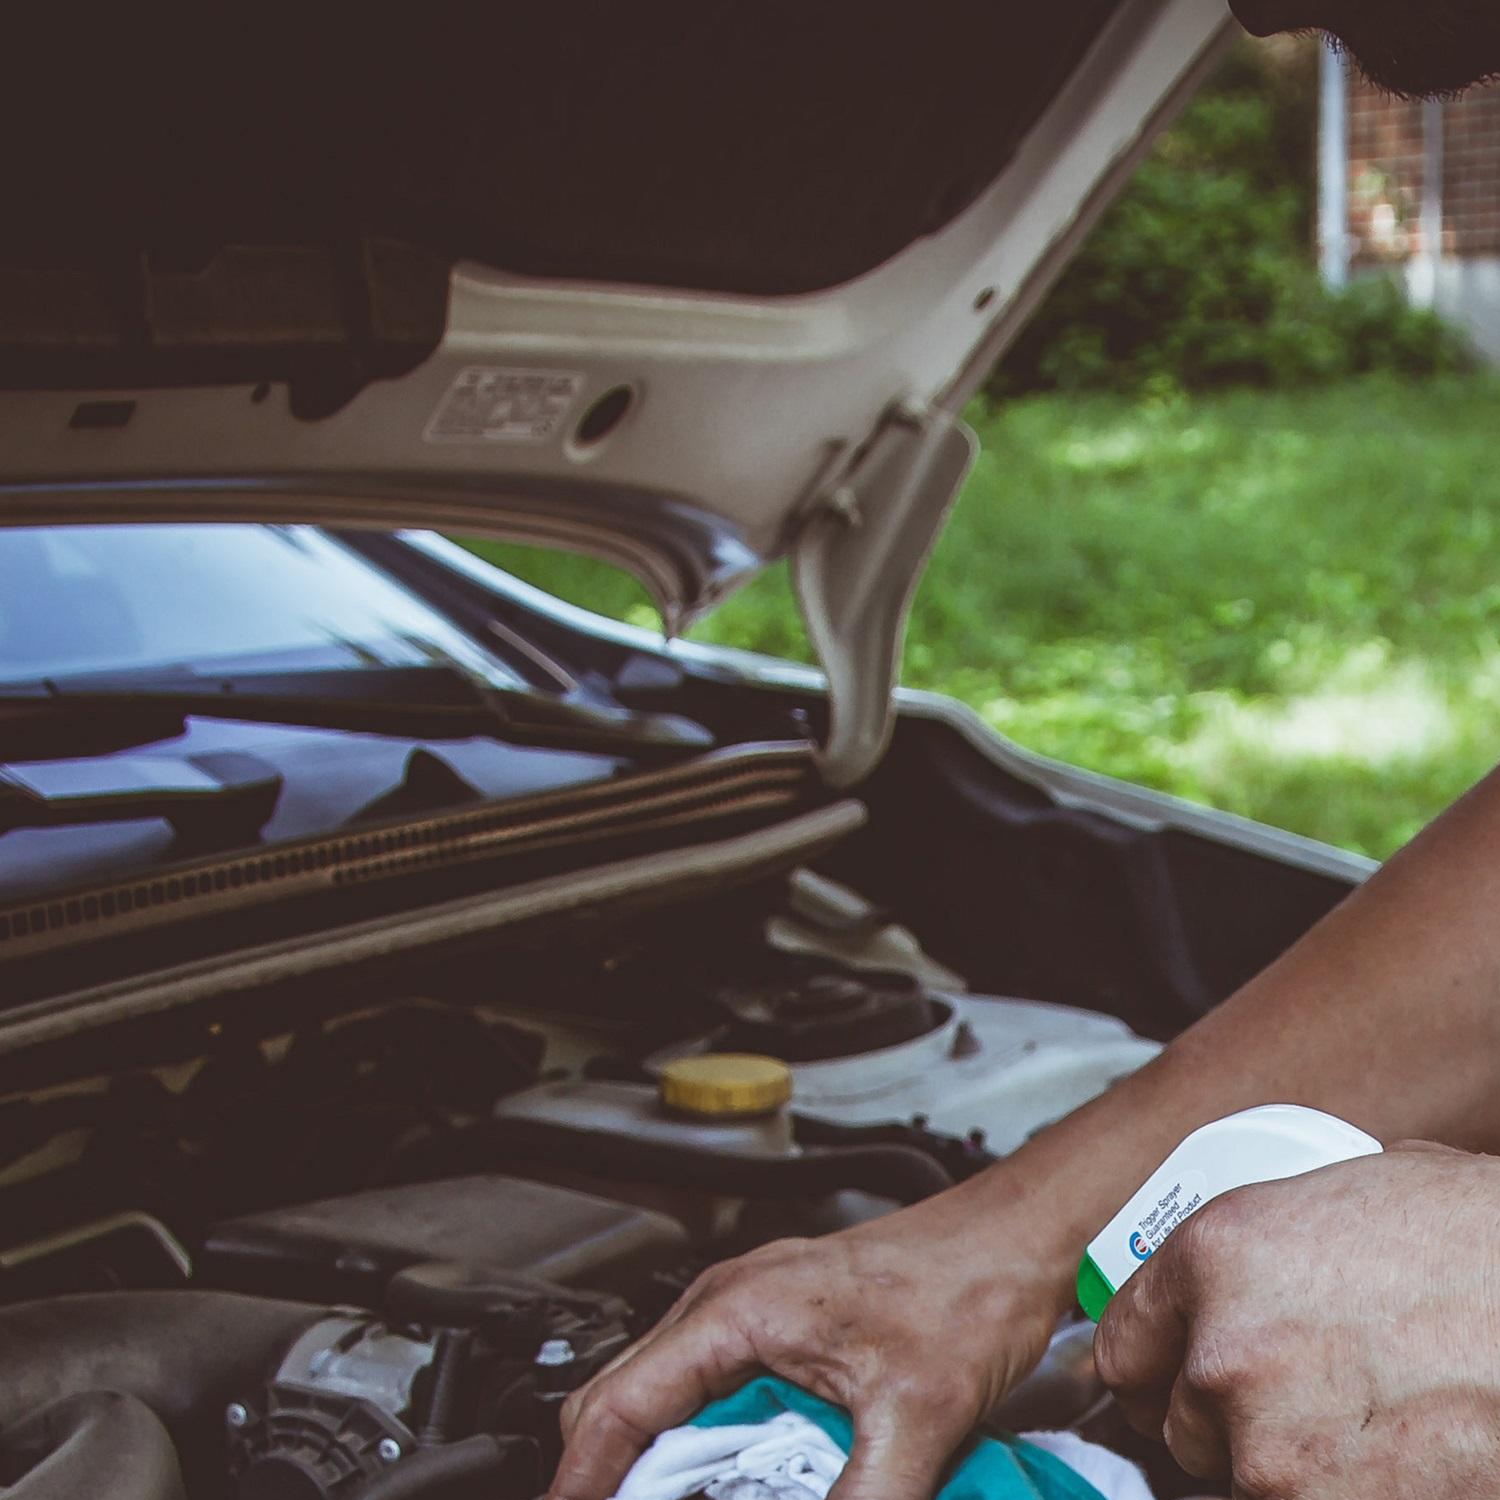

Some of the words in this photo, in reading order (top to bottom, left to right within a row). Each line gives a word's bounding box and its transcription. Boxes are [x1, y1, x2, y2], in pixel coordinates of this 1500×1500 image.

[1137, 1206, 1160, 1230] Trigger
[1156, 1182, 1182, 1209] Sprayer
[1143, 1200, 1180, 1240] Guaranteed
[1150, 1236, 1162, 1248] for
[1175, 1192, 1202, 1221] Product
